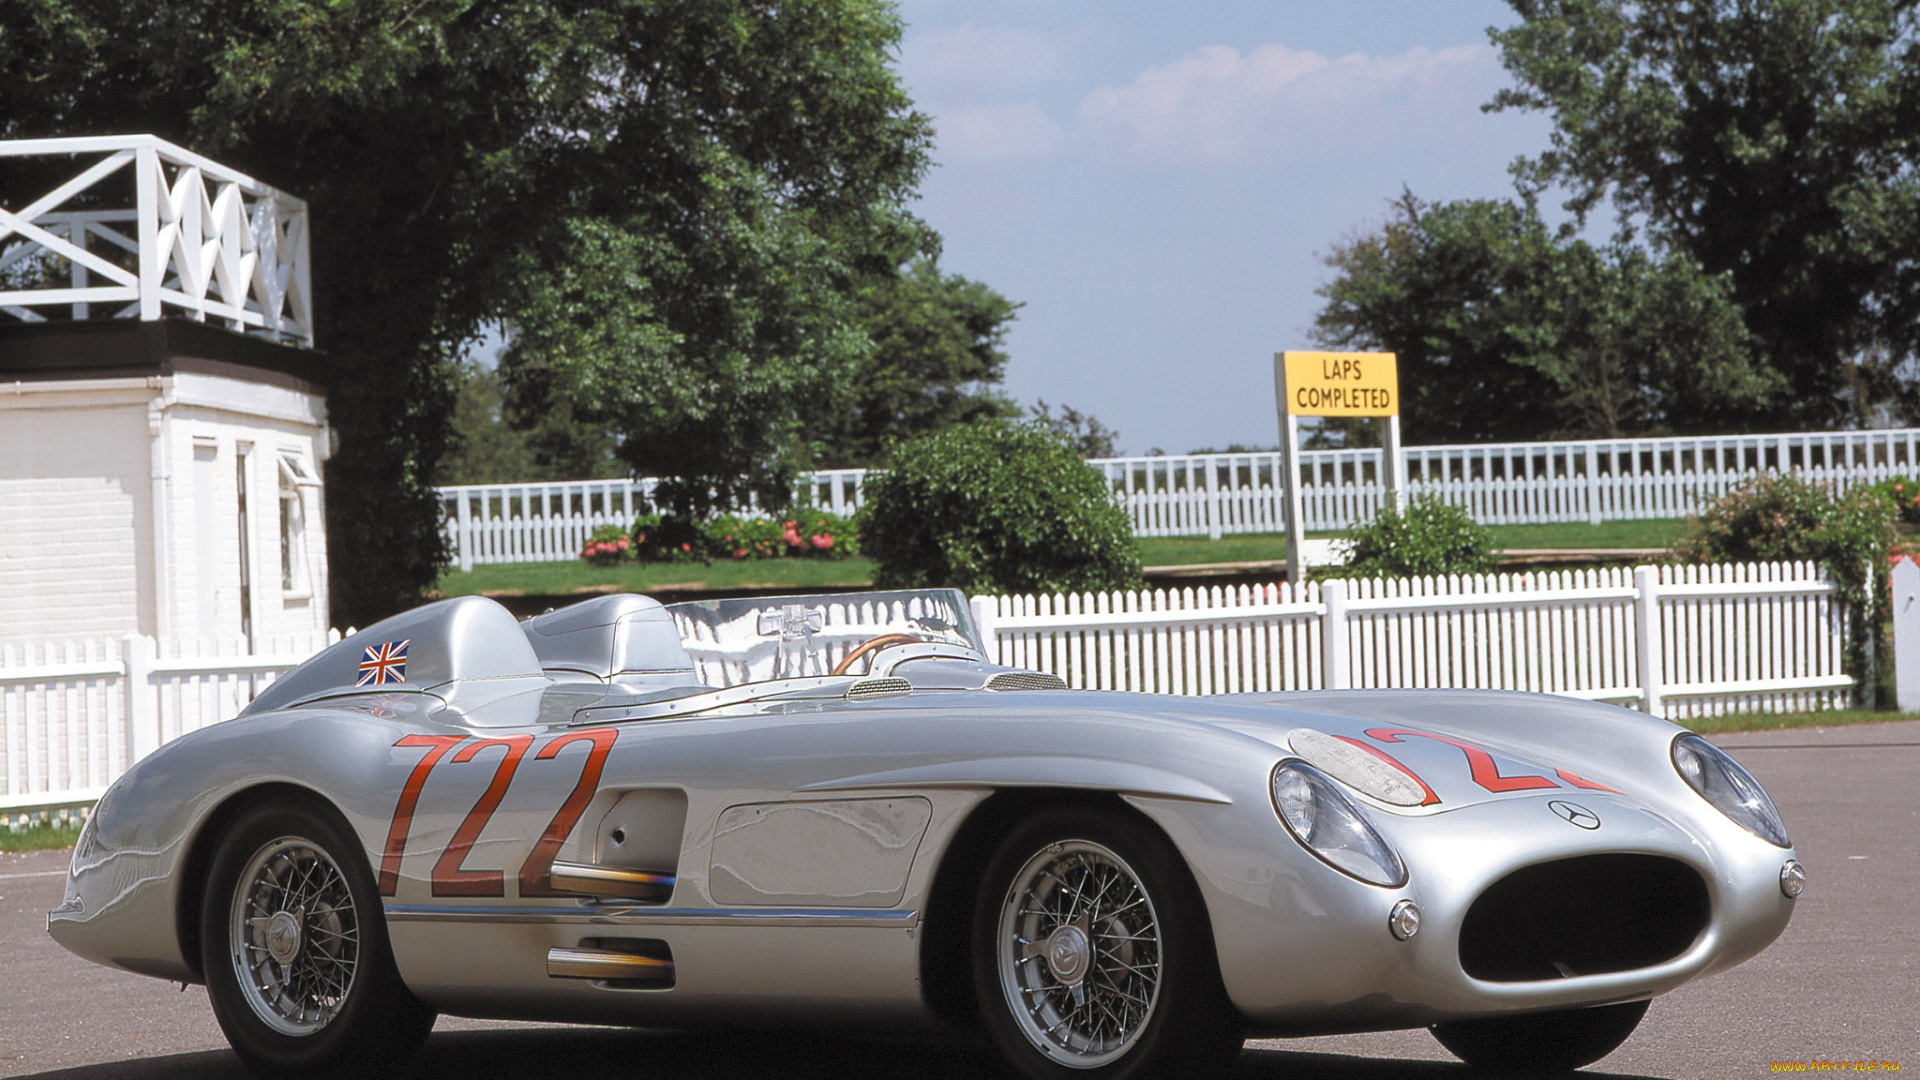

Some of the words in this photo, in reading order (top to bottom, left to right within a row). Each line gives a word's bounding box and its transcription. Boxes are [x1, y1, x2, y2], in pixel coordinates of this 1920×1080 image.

[1323, 360, 1362, 380] LAPS
[1296, 387, 1390, 408] COMPLETED
[379, 727, 619, 898] 722
